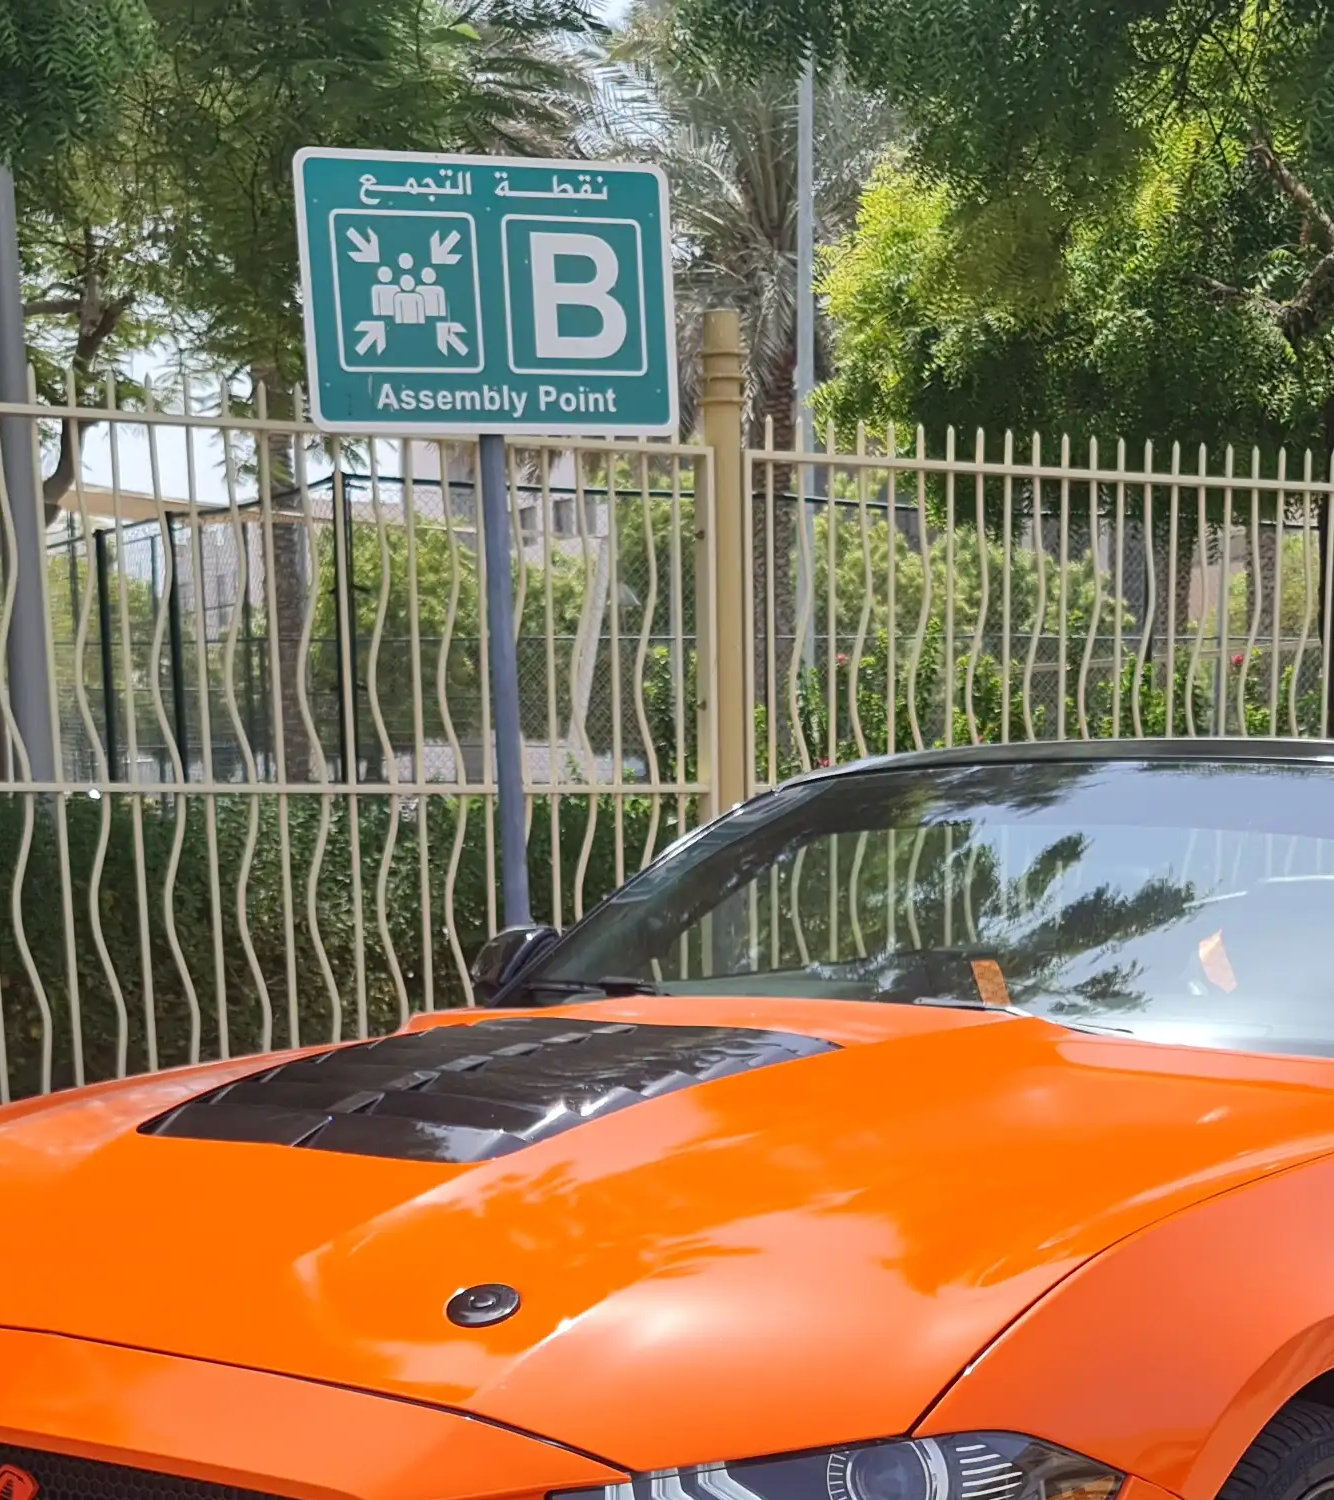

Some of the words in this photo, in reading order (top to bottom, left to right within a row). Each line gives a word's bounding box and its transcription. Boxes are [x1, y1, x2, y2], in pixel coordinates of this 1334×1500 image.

[358, 167, 472, 205] التجمع
[494, 170, 608, 200] نقطة
[529, 230, 627, 359] B
[376, 383, 528, 418] Assembly
[538, 385, 617, 412] Point
